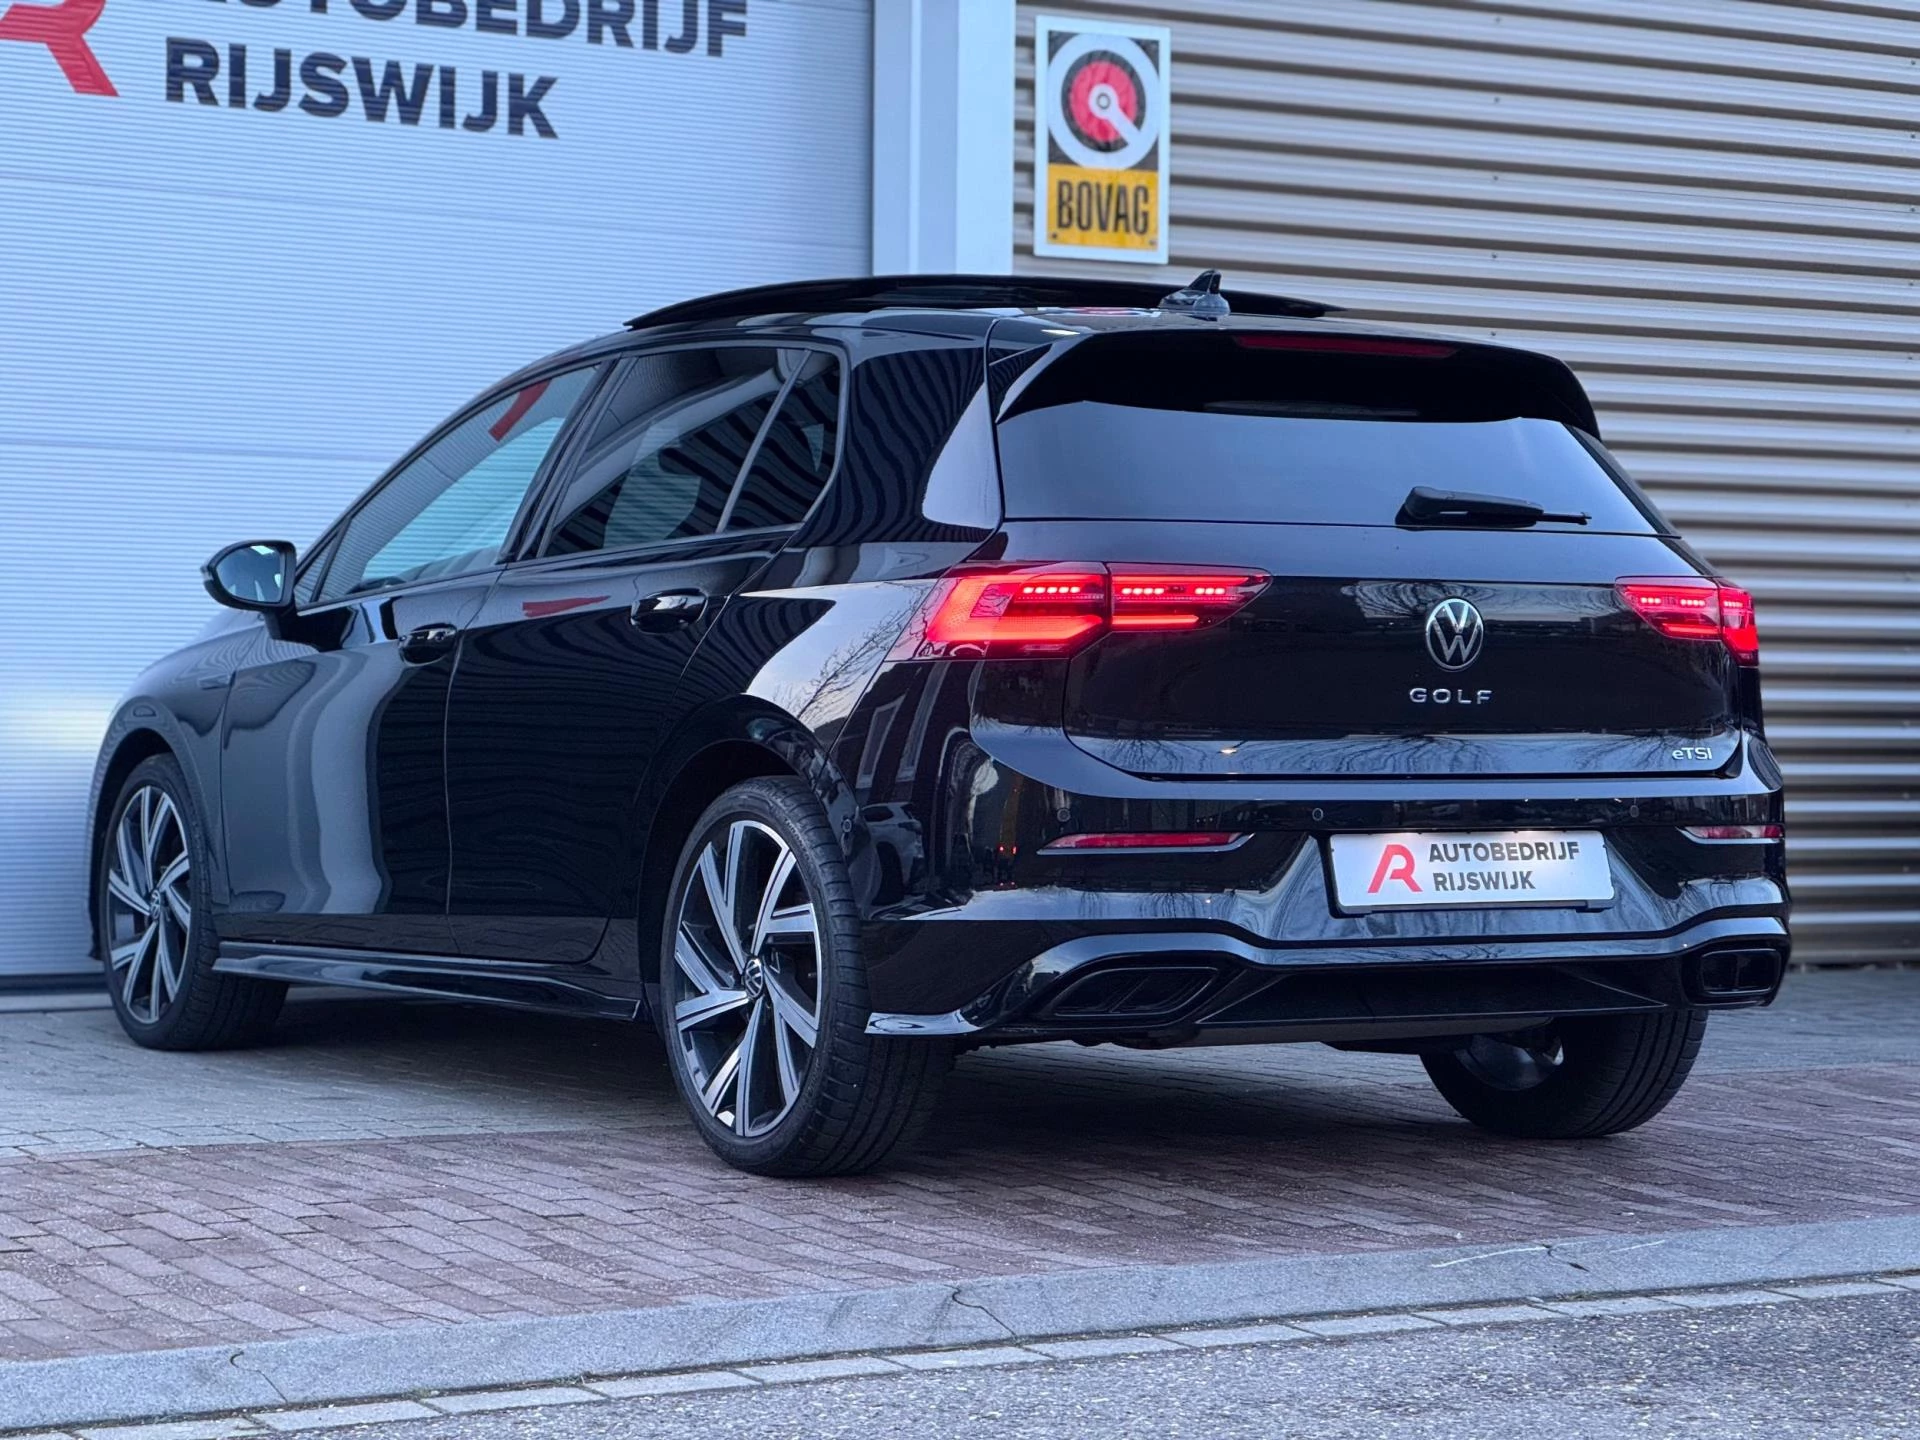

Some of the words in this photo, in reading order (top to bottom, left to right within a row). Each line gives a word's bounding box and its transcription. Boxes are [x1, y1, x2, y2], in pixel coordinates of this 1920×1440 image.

[165, 36, 560, 139] RIJSWIJK
[1057, 180, 1150, 236] BOVAG
[1409, 687, 1493, 705] GOLF
[1671, 746, 1713, 760] eTSI
[1429, 841, 1580, 863] AUTOBEDRIJF
[1432, 870, 1536, 892] RIJSWIJK
